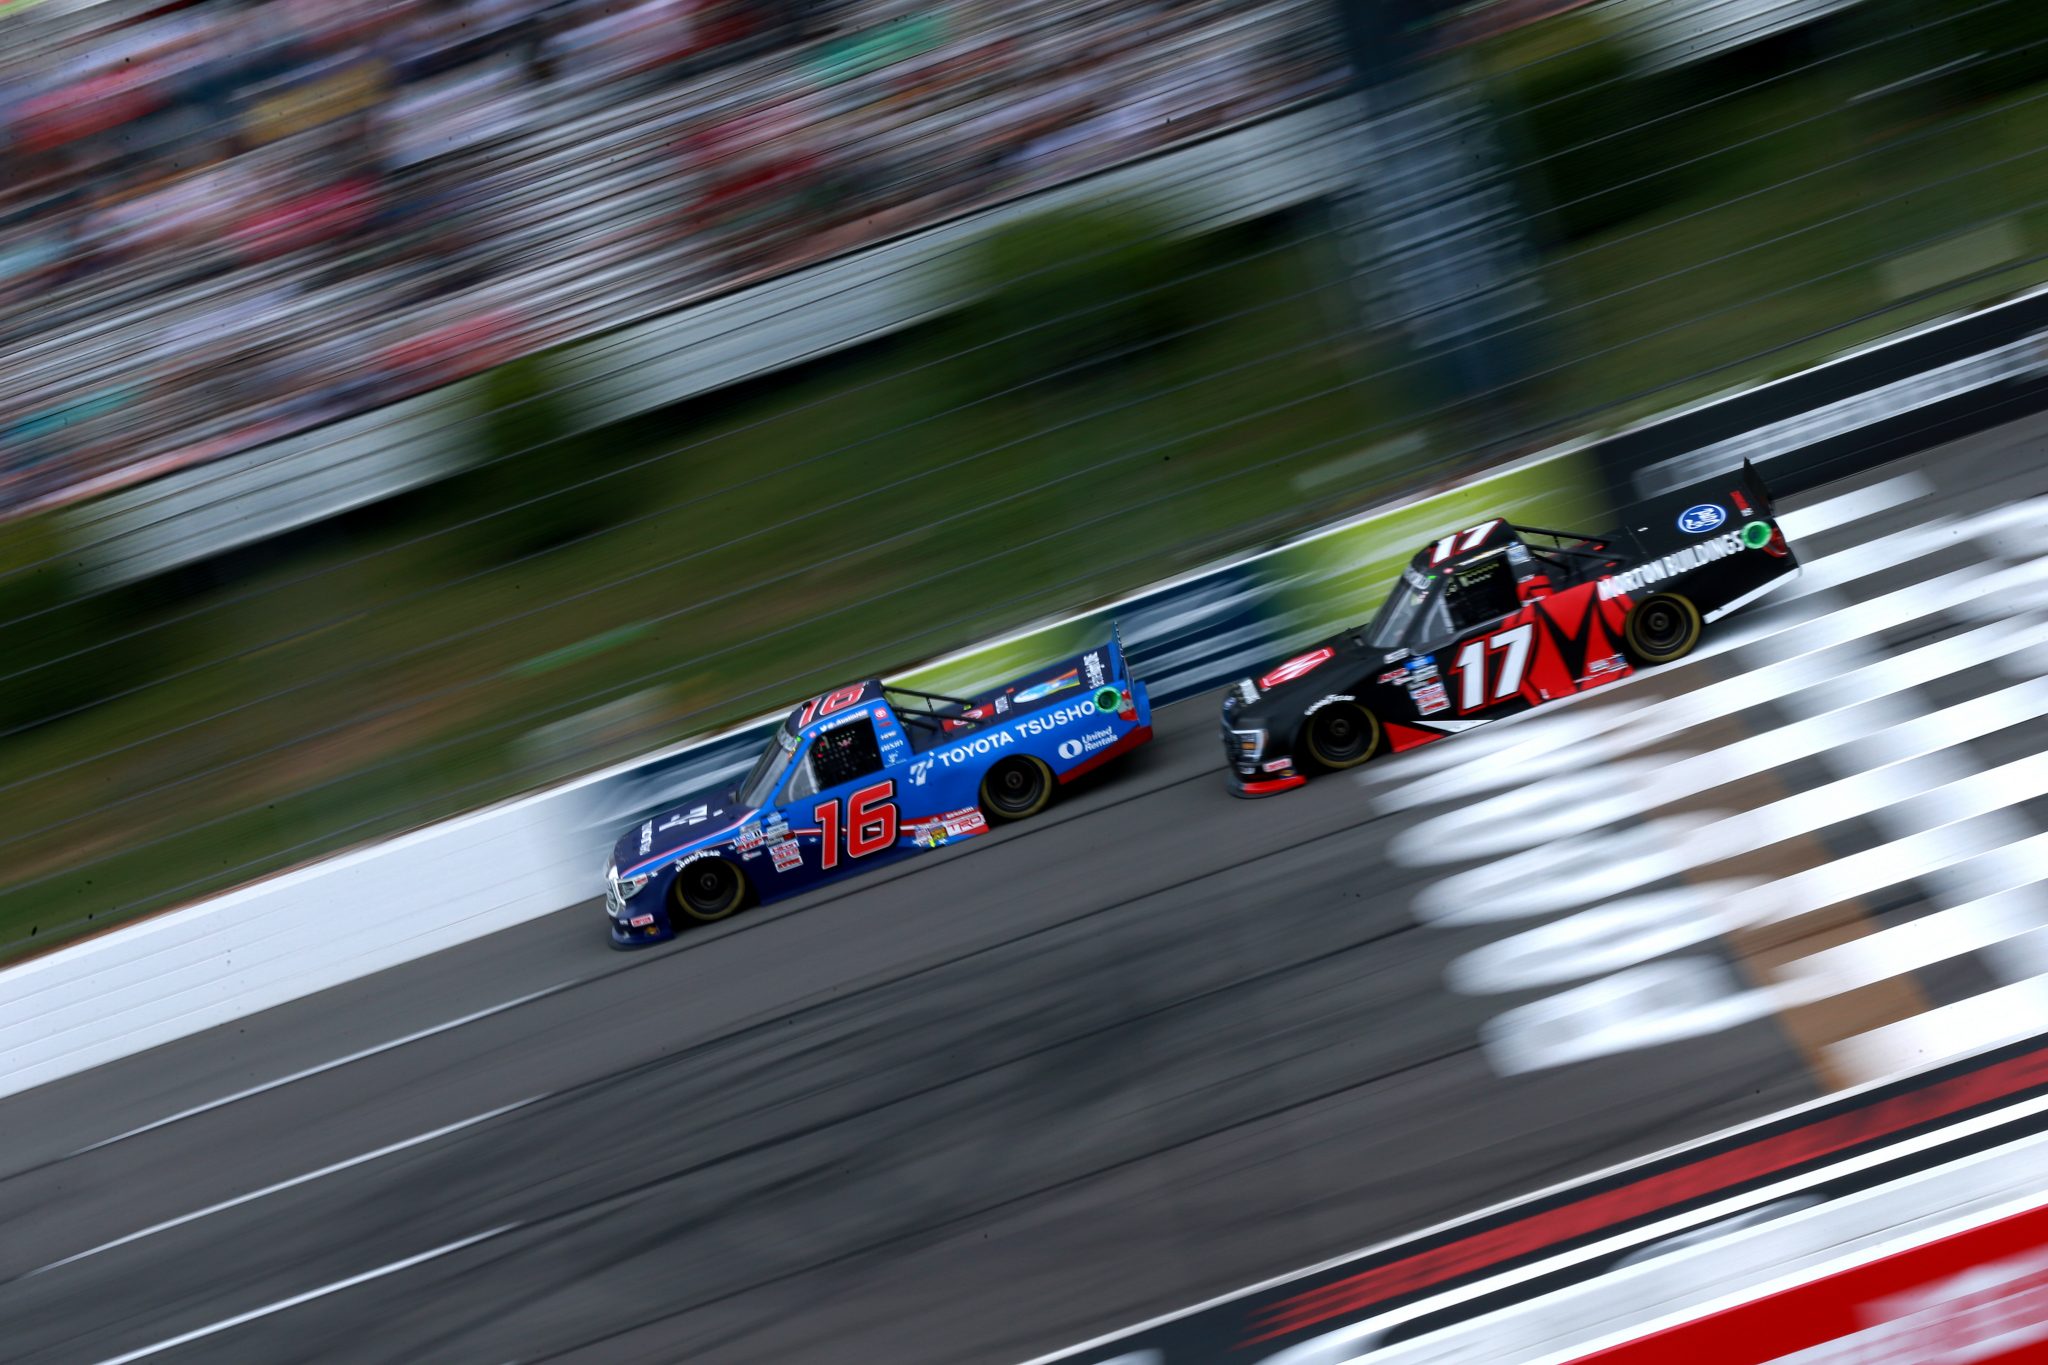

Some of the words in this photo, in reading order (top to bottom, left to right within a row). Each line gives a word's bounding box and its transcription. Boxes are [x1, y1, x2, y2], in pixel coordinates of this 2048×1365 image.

[1431, 519, 1500, 566] 17
[1455, 622, 1535, 712] 17
[938, 731, 1014, 767] TOYOTA
[1015, 700, 1097, 739] TSUSHO
[1081, 726, 1112, 744] United
[1084, 734, 1118, 753] Rentals
[815, 780, 897, 870] 16
